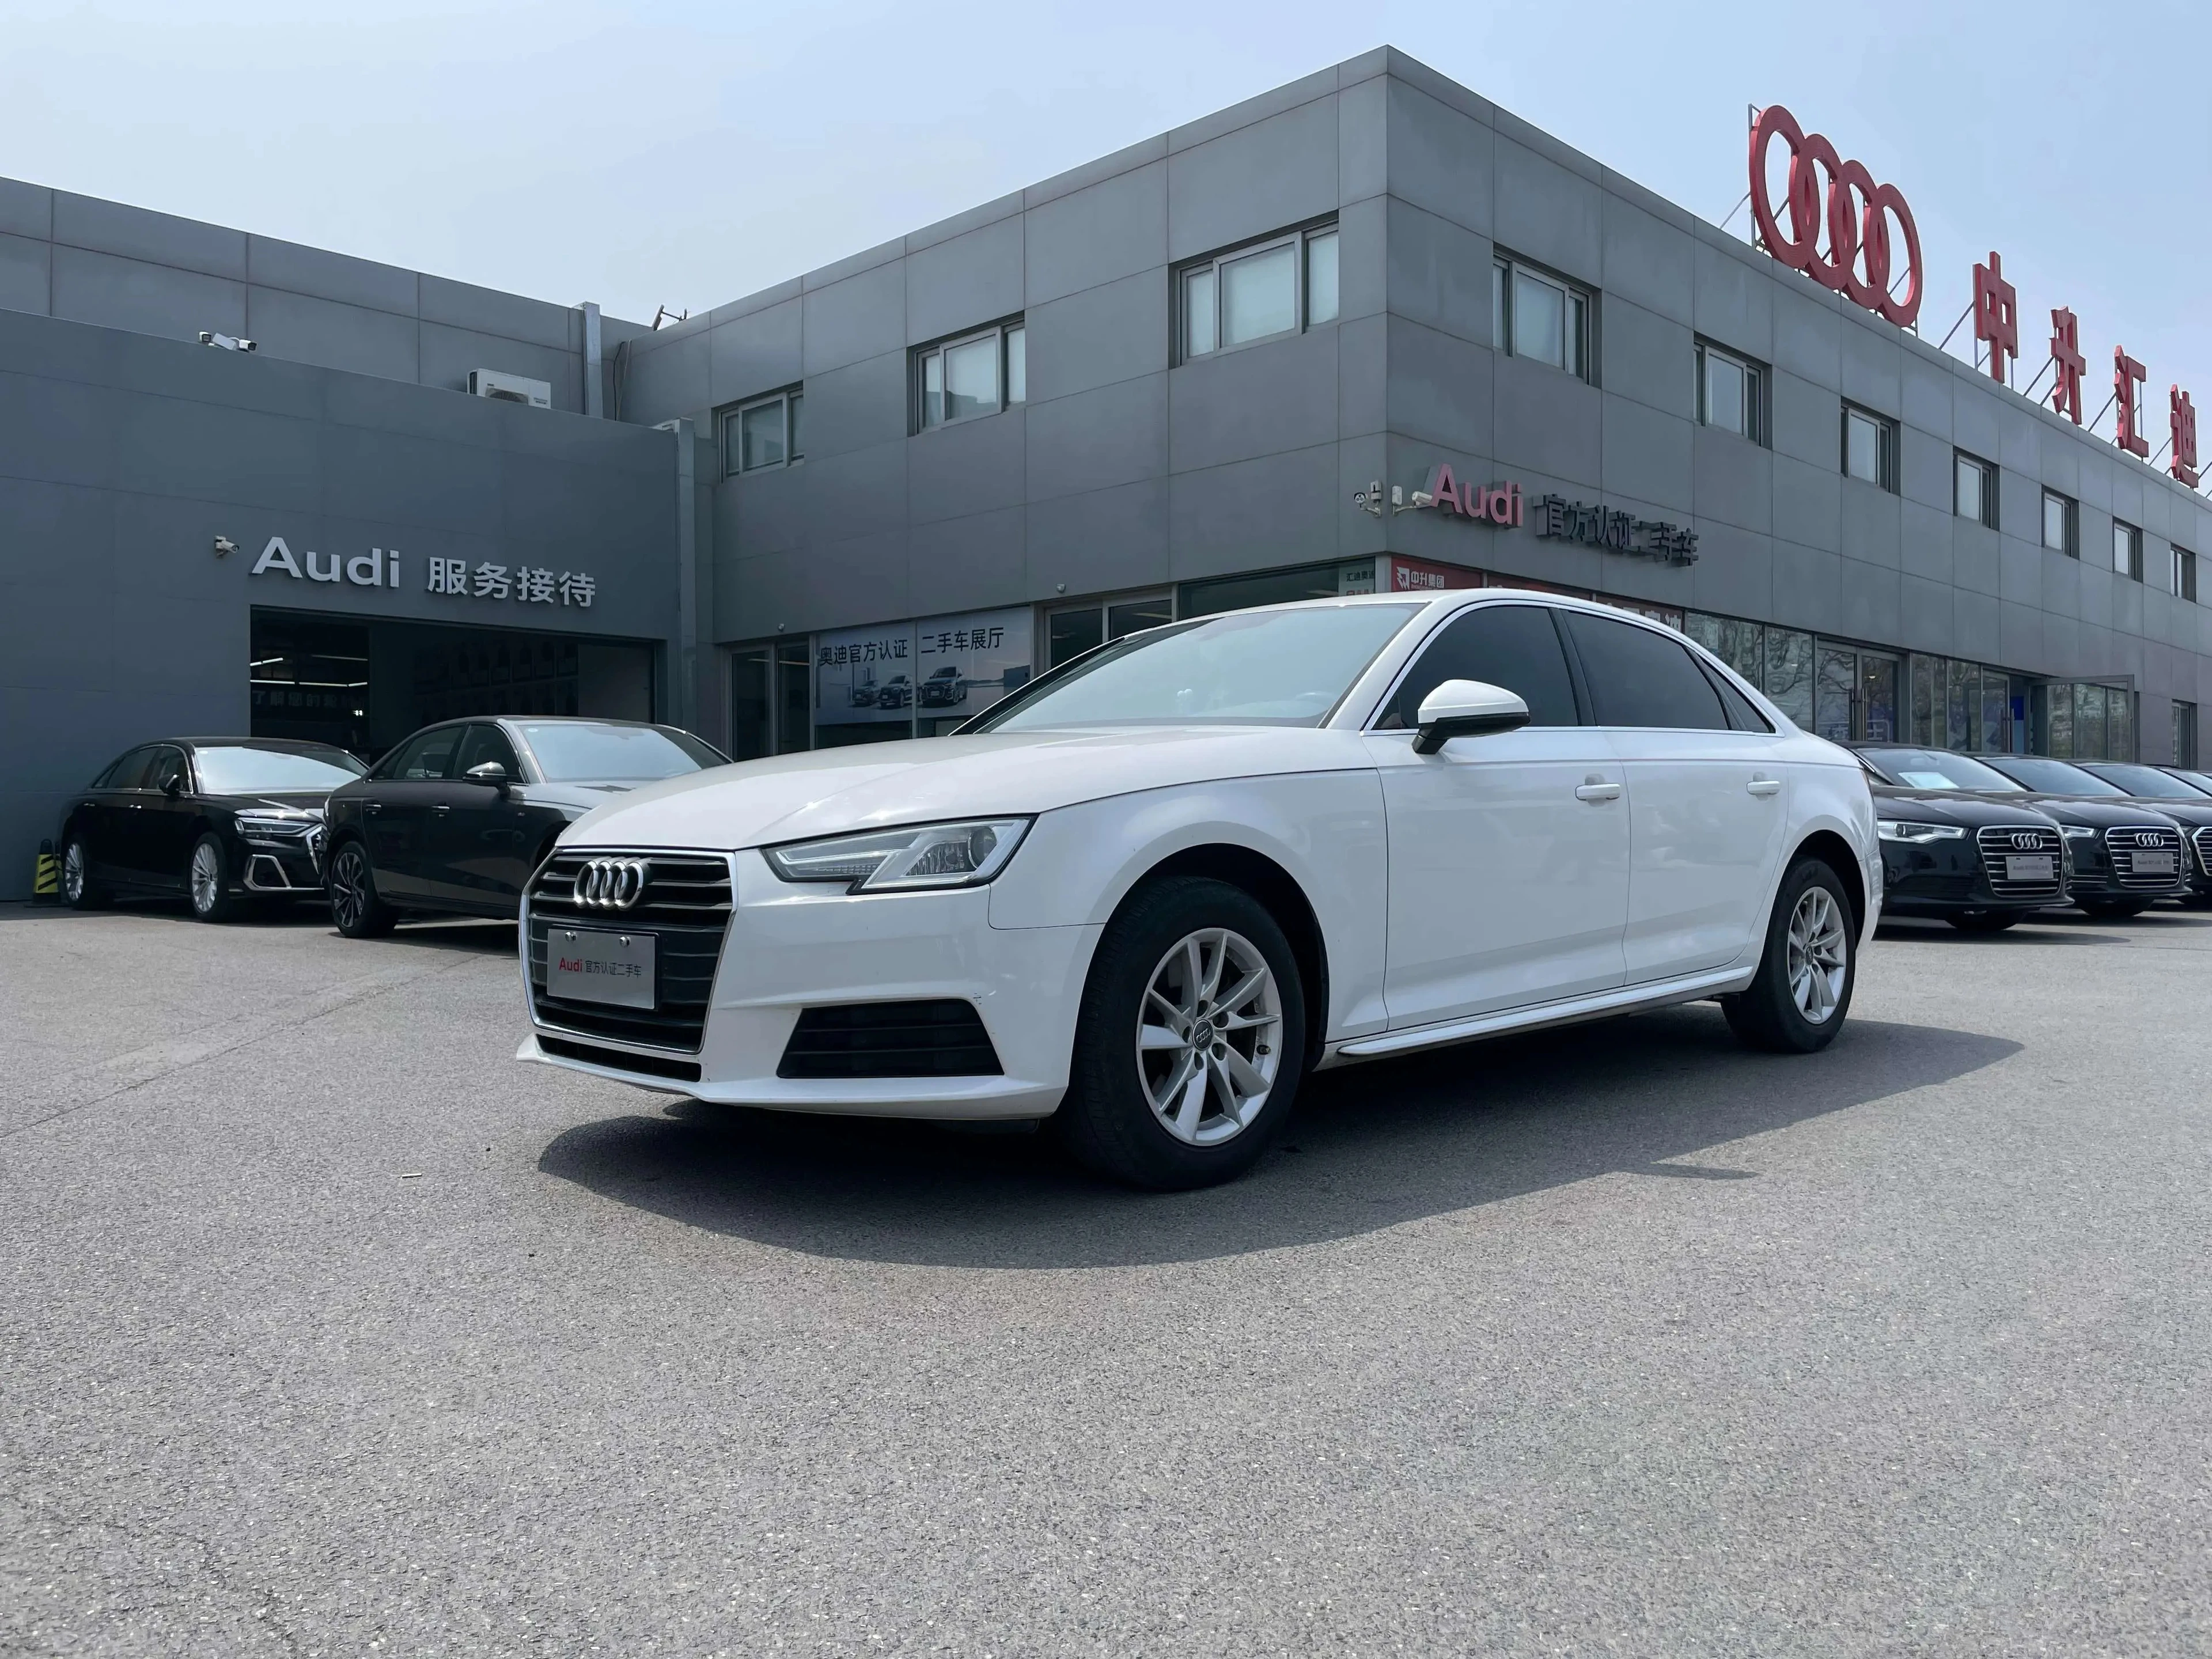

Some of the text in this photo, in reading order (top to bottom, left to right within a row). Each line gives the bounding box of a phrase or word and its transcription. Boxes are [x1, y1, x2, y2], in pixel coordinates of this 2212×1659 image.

[1972, 250, 2199, 488] 中升汇迪
[1428, 463, 1699, 566] Audi 官方认证二手车
[252, 536, 596, 607] Audi 服务接待
[1411, 571, 1445, 588] 中升集团
[819, 627, 1005, 666] 奥迪官方认证 二手车展厅
[559, 957, 642, 978] Audi 官方认证二手车
